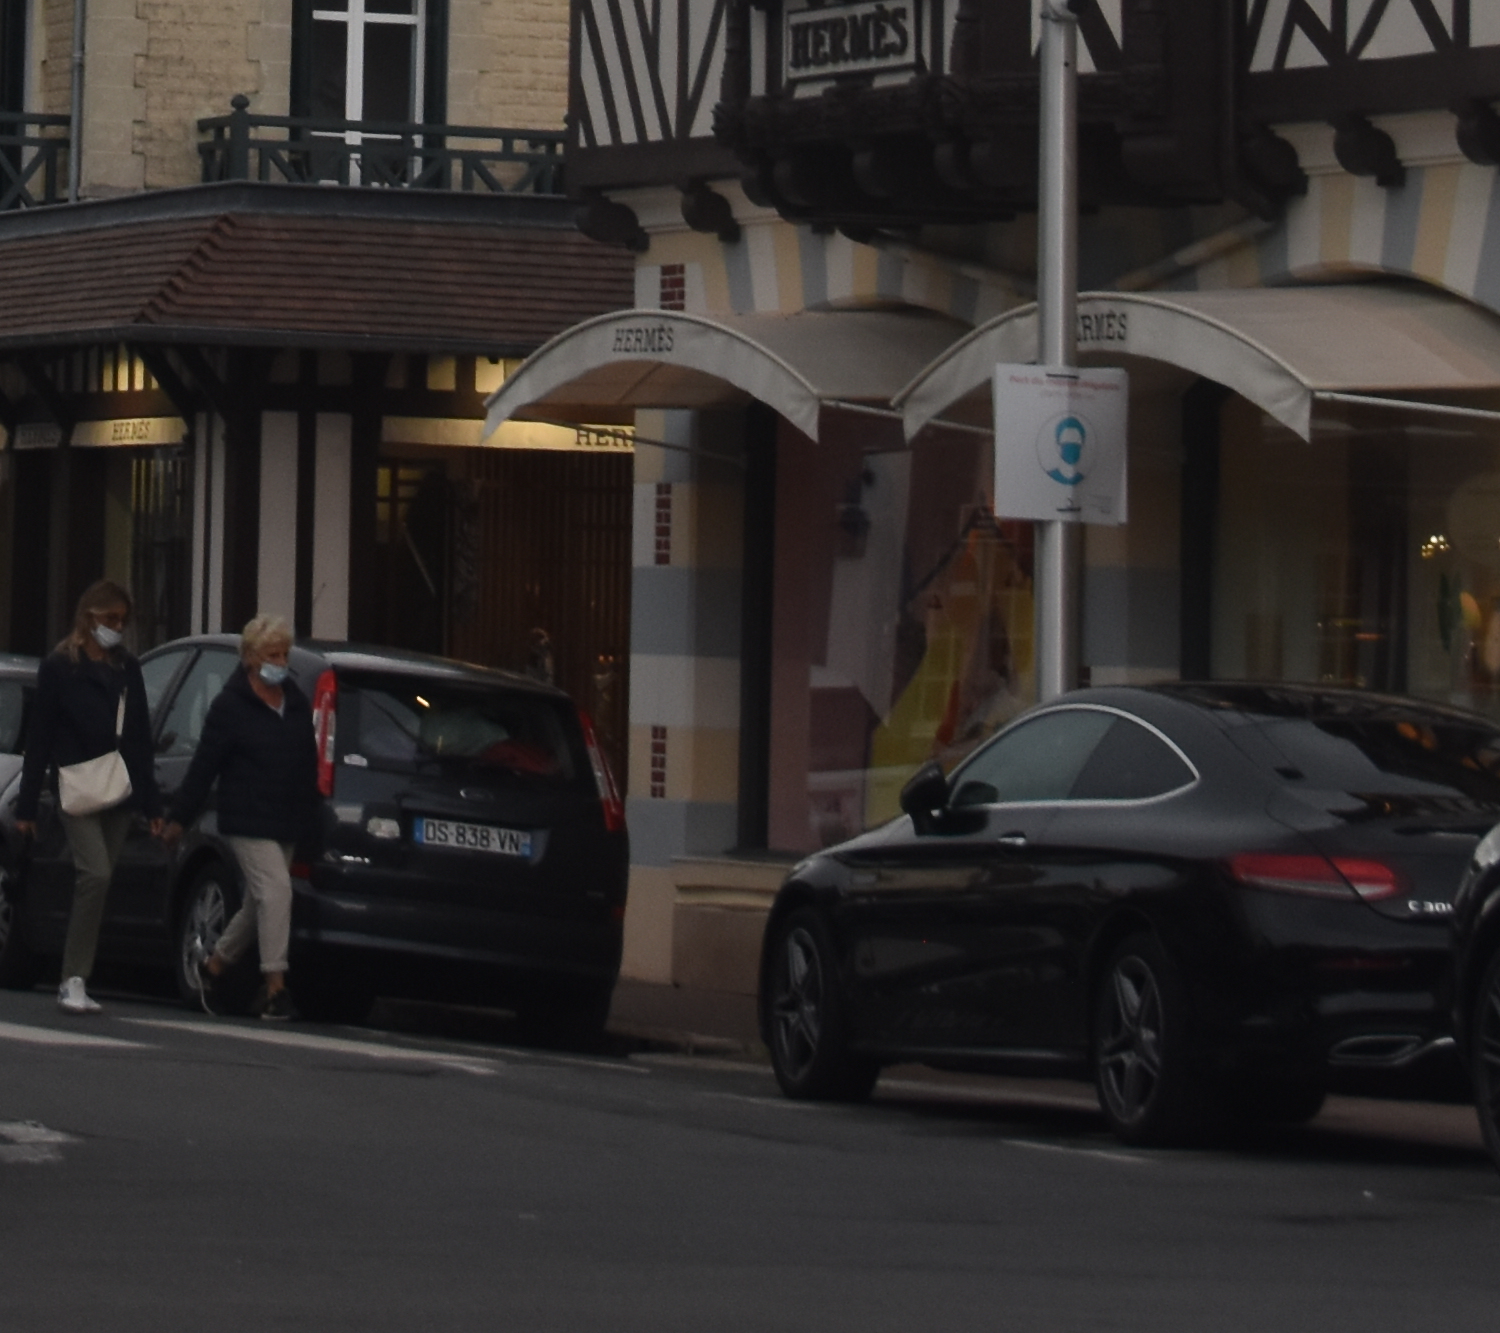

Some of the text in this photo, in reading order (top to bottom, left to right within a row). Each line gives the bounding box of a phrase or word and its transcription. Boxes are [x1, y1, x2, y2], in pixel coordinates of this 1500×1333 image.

[790, 3, 908, 68] HERMÈS
[612, 324, 674, 352] HERMÈS
[425, 821, 520, 852] DS-838-VN
